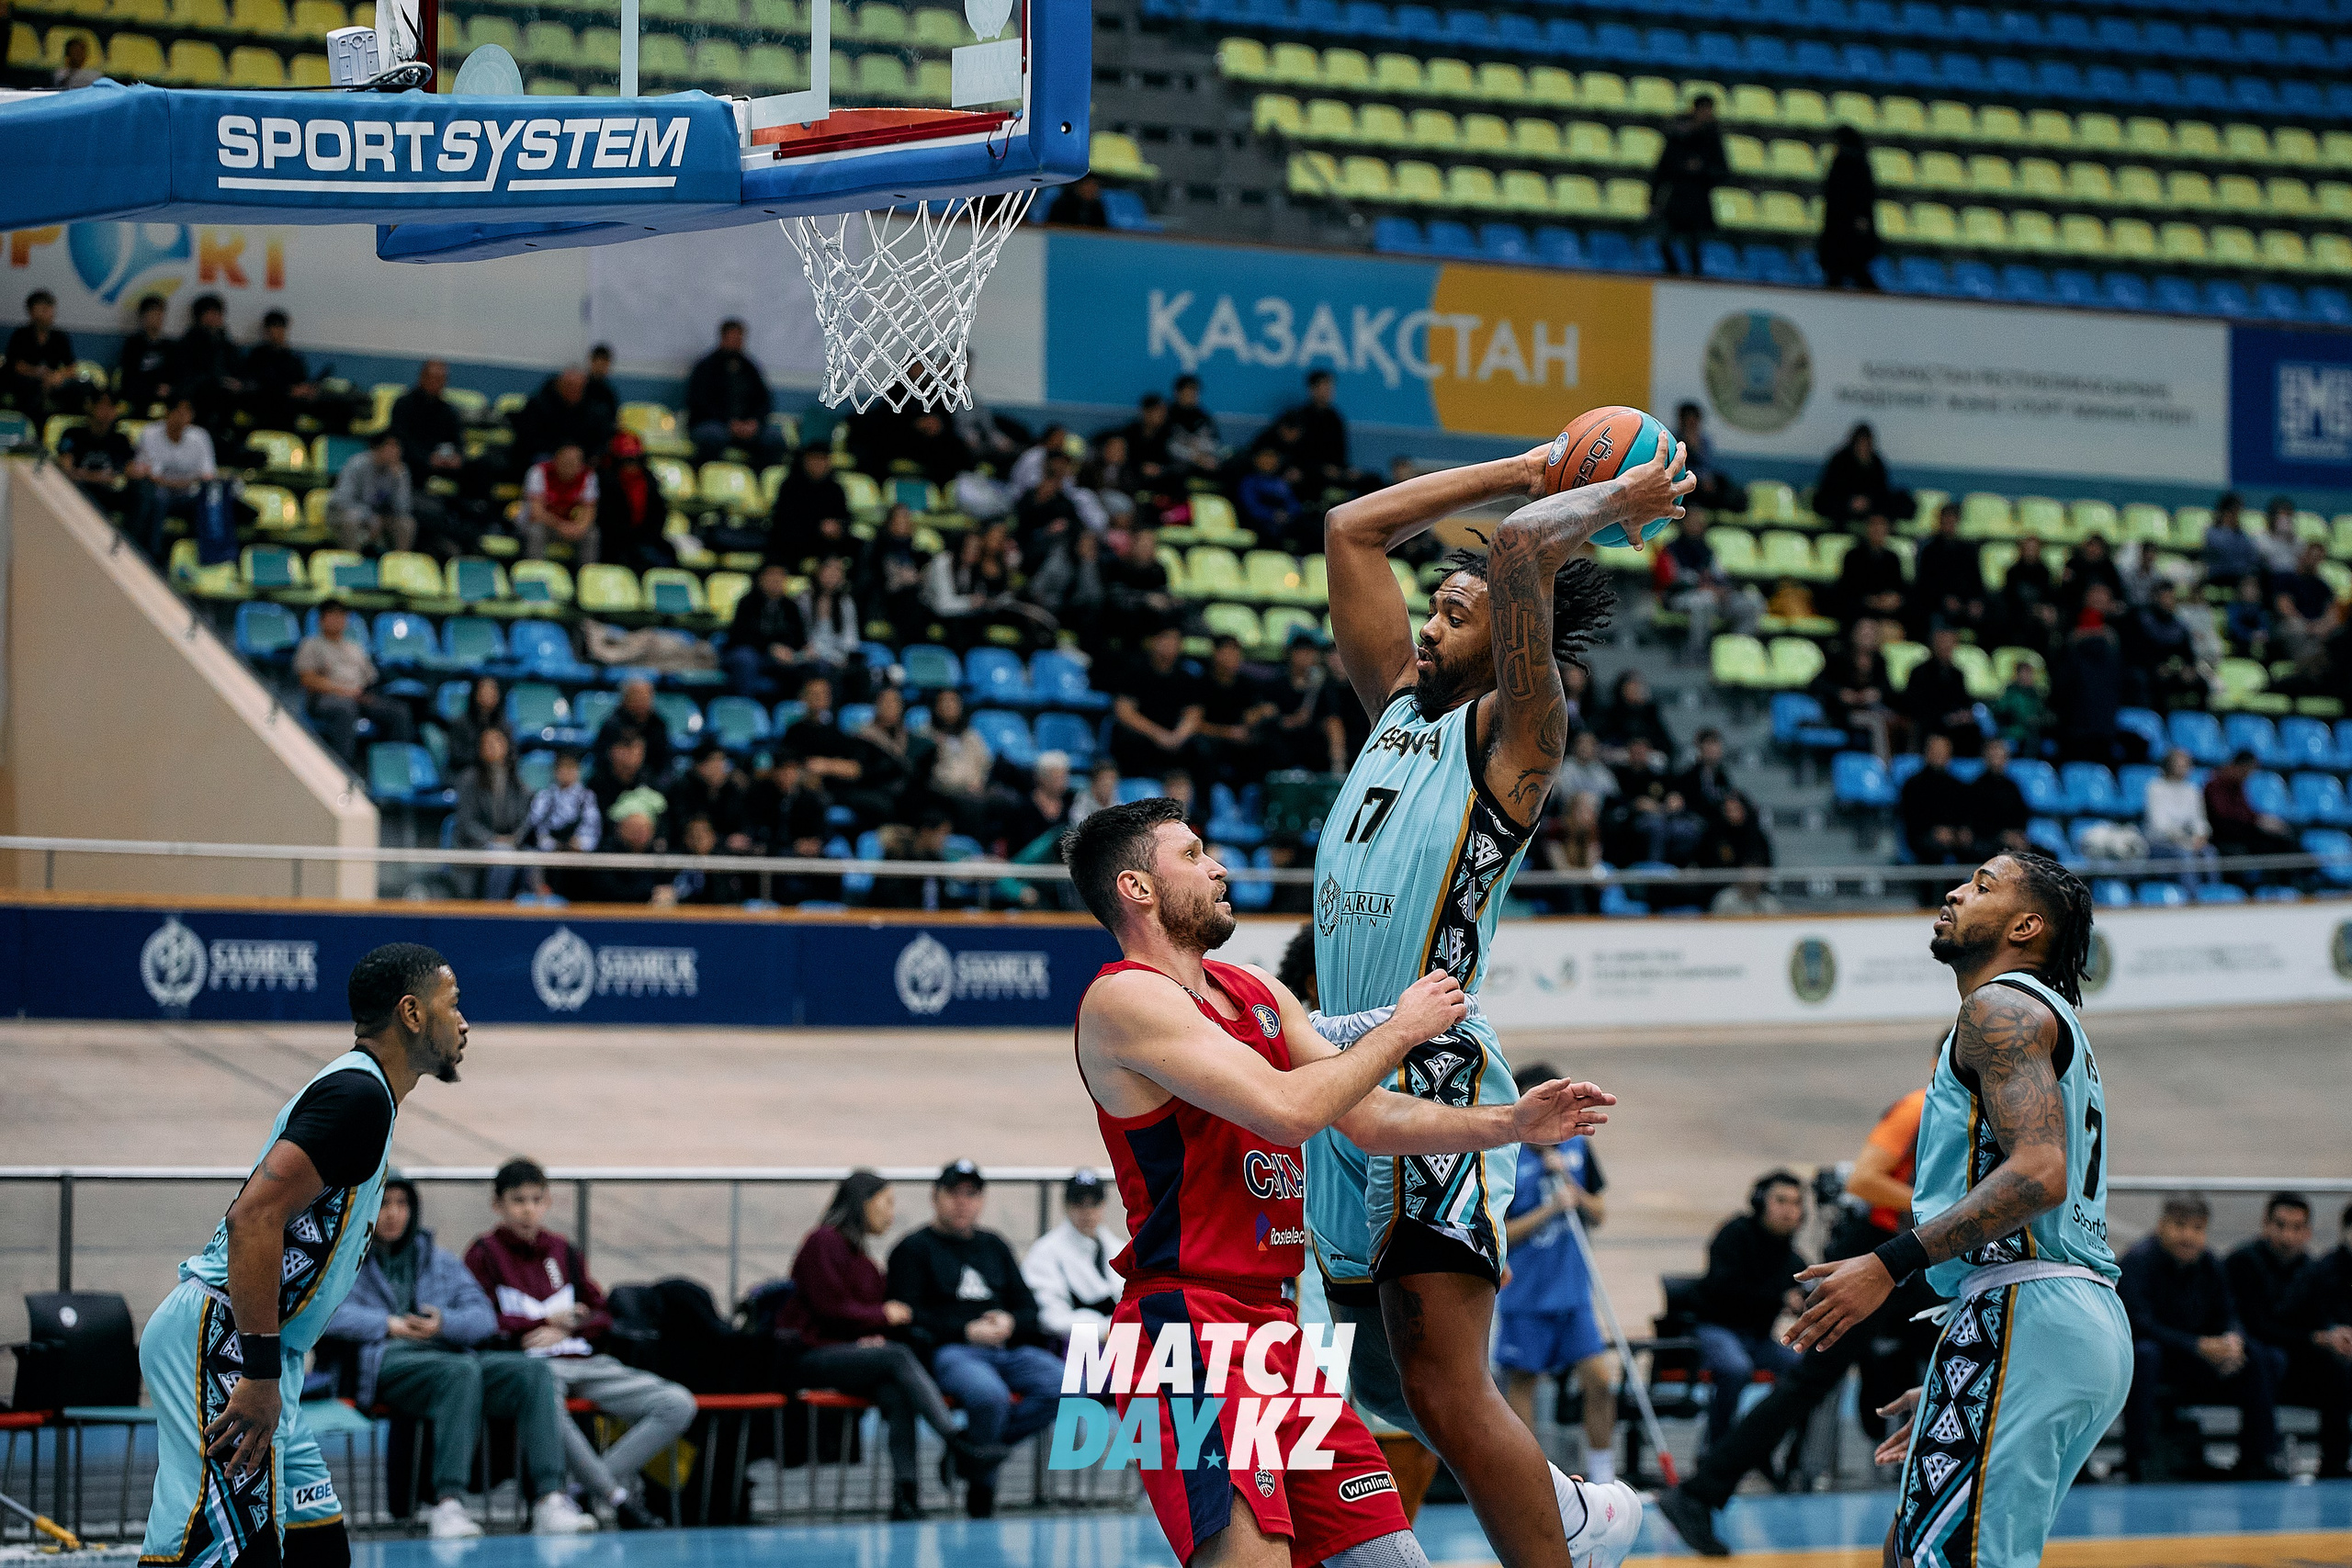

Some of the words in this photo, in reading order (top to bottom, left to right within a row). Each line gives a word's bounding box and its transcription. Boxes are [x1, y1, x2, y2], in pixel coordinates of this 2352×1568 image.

[1148, 289, 1581, 389] ҚАЗАҚСТАН
[1344, 787, 1400, 843] 17
[1345, 1476, 1390, 1497] Winline
